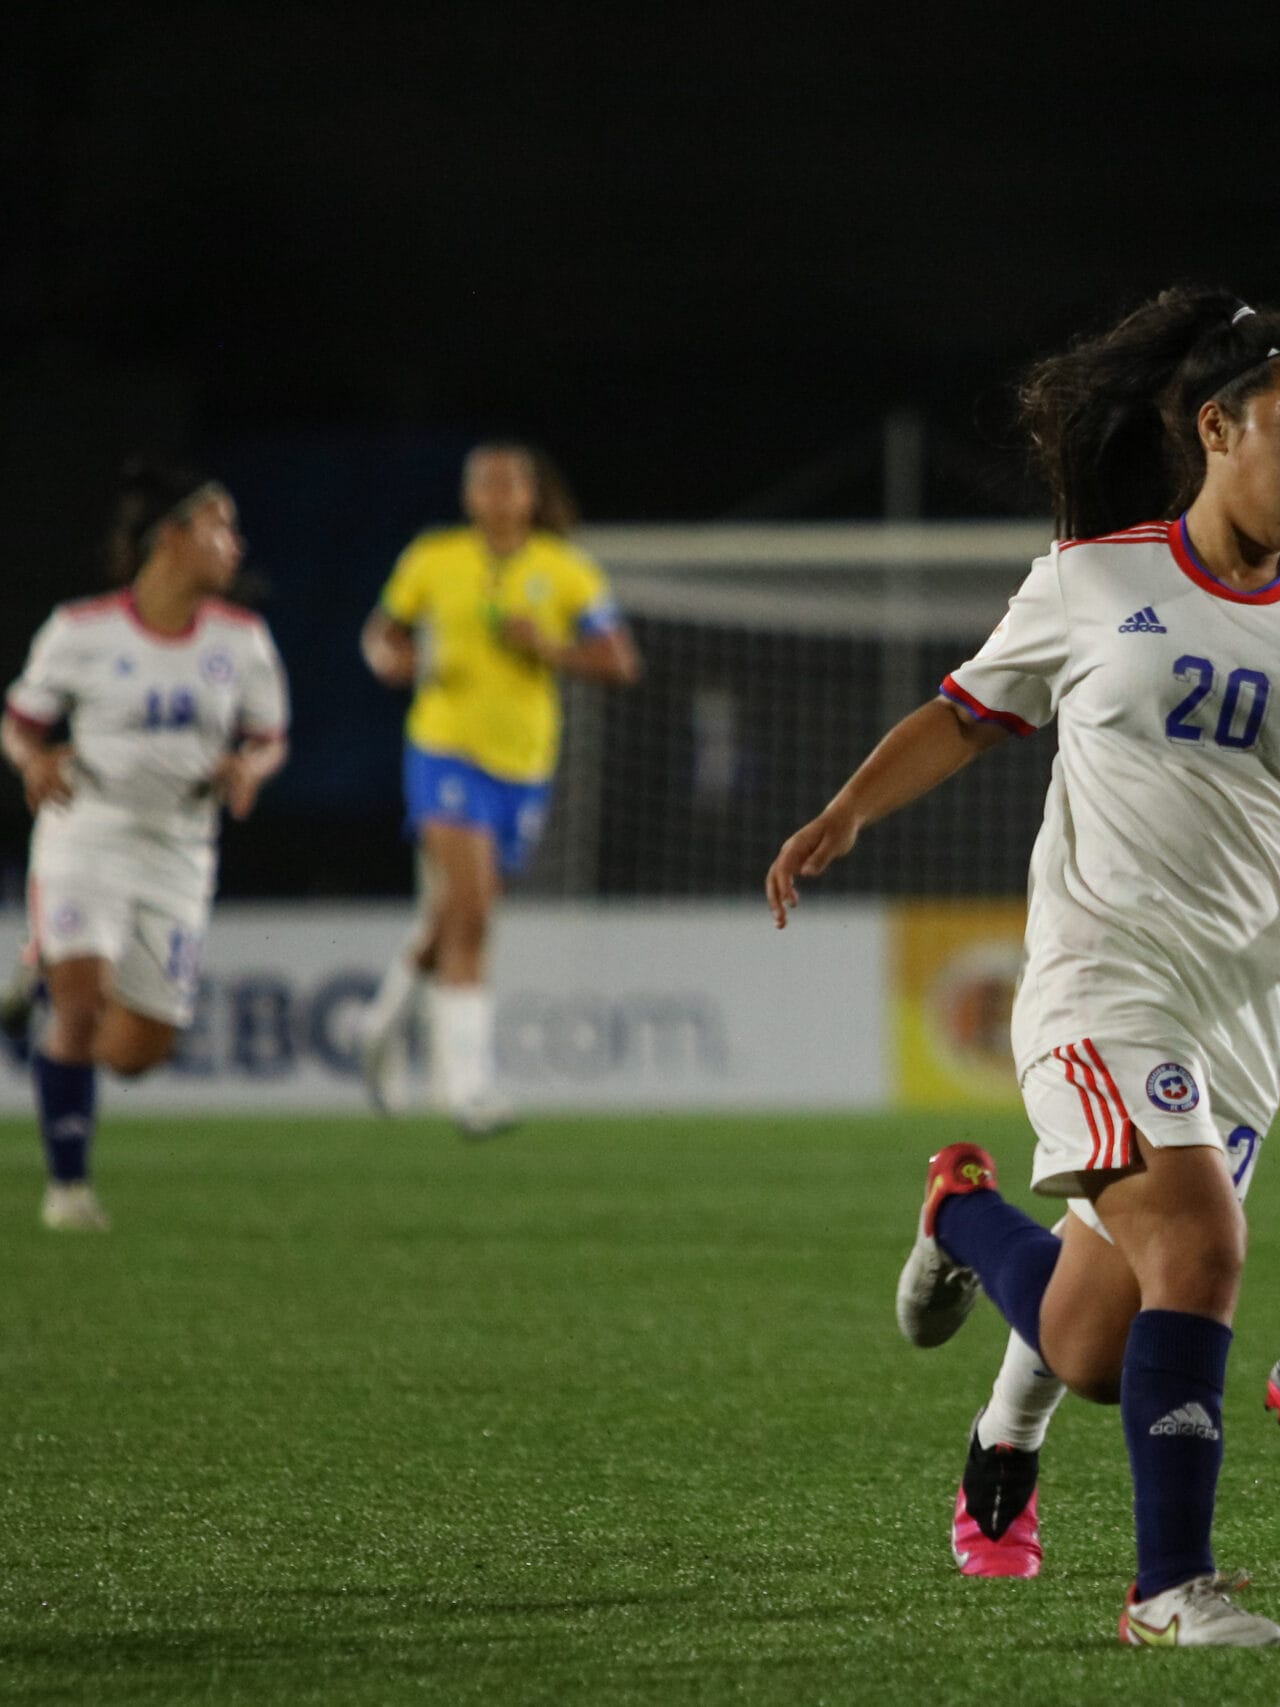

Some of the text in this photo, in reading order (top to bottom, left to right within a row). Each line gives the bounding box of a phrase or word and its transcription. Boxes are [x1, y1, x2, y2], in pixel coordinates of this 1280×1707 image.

[1118, 622, 1168, 634] adidas
[1165, 654, 1270, 750] 20
[1149, 1421, 1219, 1441] adidas
